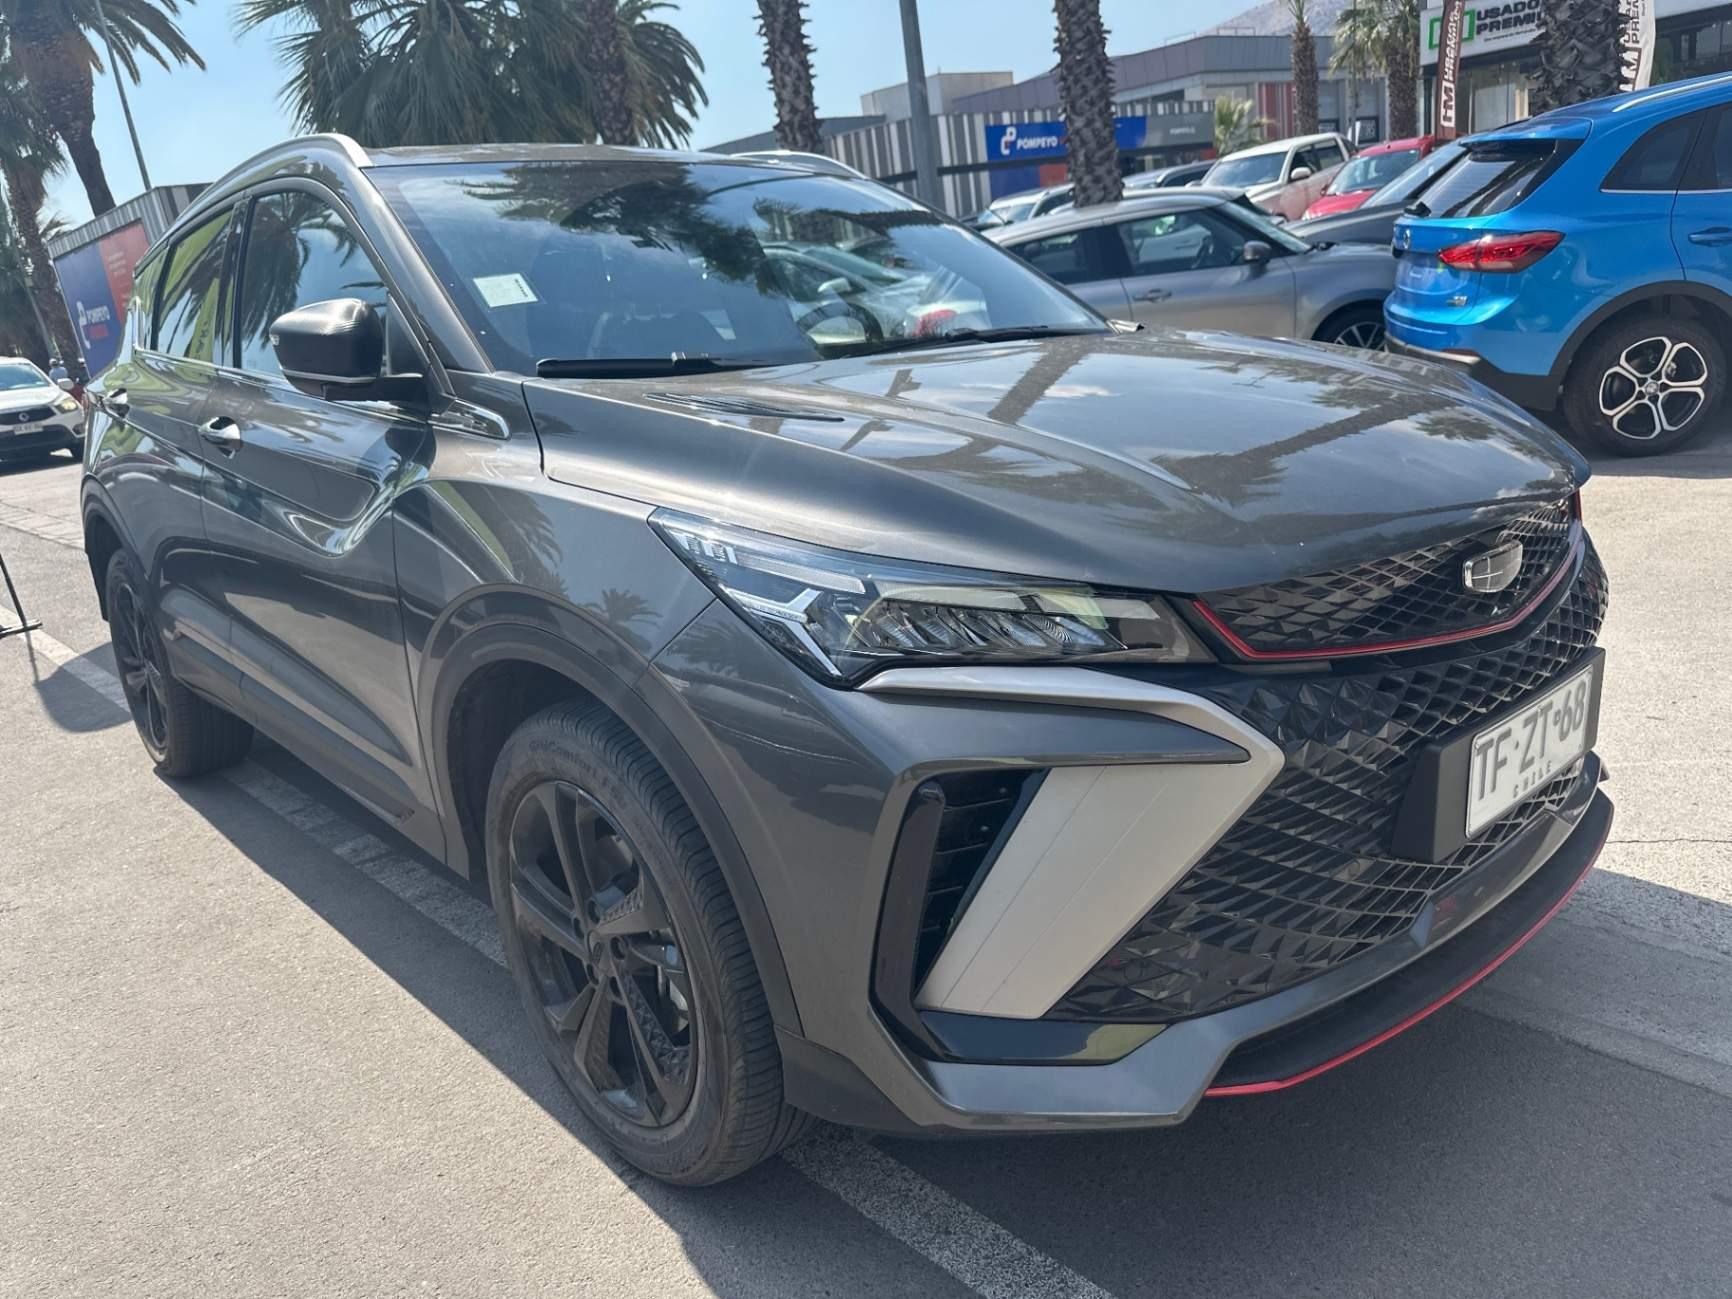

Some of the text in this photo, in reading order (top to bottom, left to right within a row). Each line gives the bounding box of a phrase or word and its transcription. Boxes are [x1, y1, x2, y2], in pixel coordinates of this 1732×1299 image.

[1477, 0, 1540, 21] USADO
[1476, 12, 1541, 35] PREMI
[1016, 136, 1058, 150] POMPEYO
